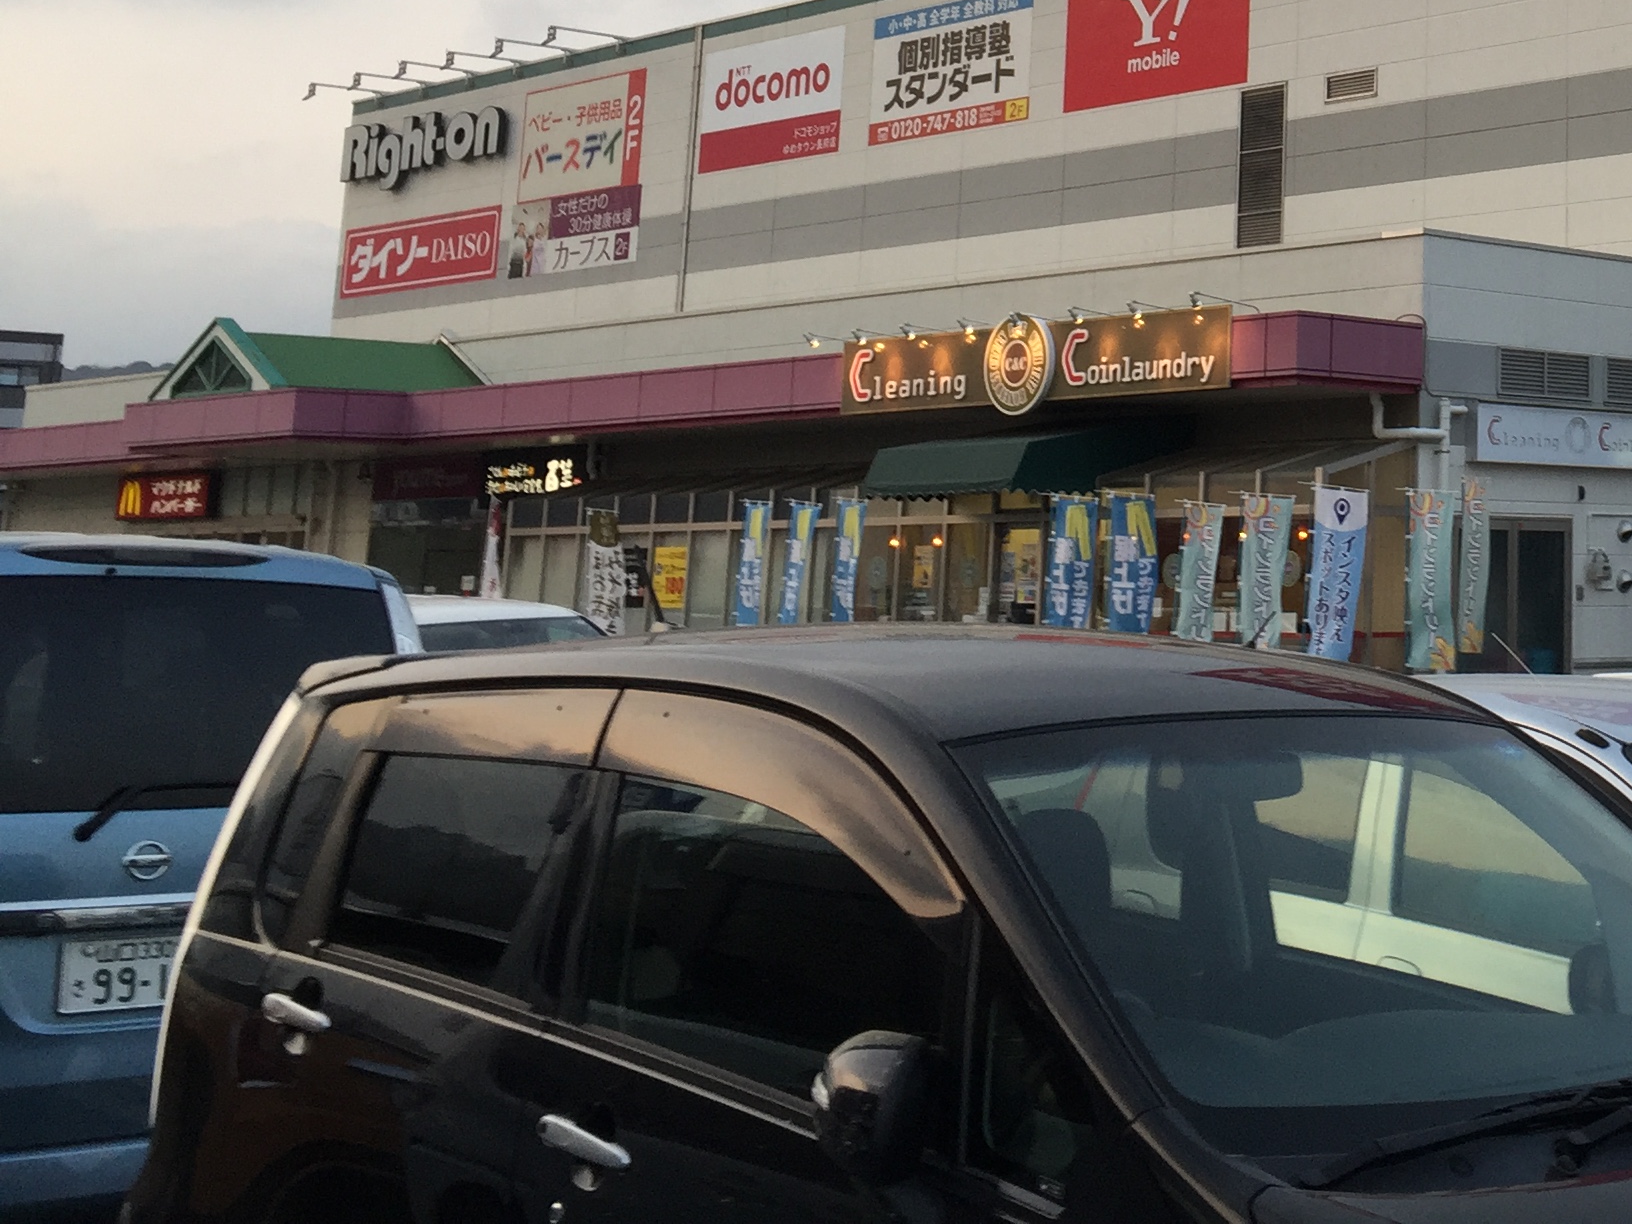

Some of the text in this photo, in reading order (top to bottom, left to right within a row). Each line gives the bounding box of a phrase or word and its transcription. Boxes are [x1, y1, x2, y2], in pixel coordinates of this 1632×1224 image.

[929, 6, 961, 25] 全学年
[898, 20, 1011, 75] 個別指導塾
[1126, 48, 1180, 74] mobile
[715, 62, 831, 111] docomo
[735, 65, 752, 77] NTT
[884, 55, 1015, 112] スタンダード
[793, 121, 838, 139] ドコモショップ
[891, 108, 978, 139] 0120-747-818
[1009, 102, 1024, 118] 2F
[340, 105, 504, 191] Right-on
[522, 128, 623, 180] バースデイ
[553, 193, 609, 217] 女性だけの
[350, 230, 491, 283] ダイソー DAISO
[615, 238, 628, 256] 2F
[849, 348, 967, 403] Cleaning
[1005, 357, 1027, 371] C&C
[1061, 328, 1215, 386] Coinlaundry
[1330, 536, 1357, 643] インスタ映え
[93, 963, 170, 1005] 99-1
